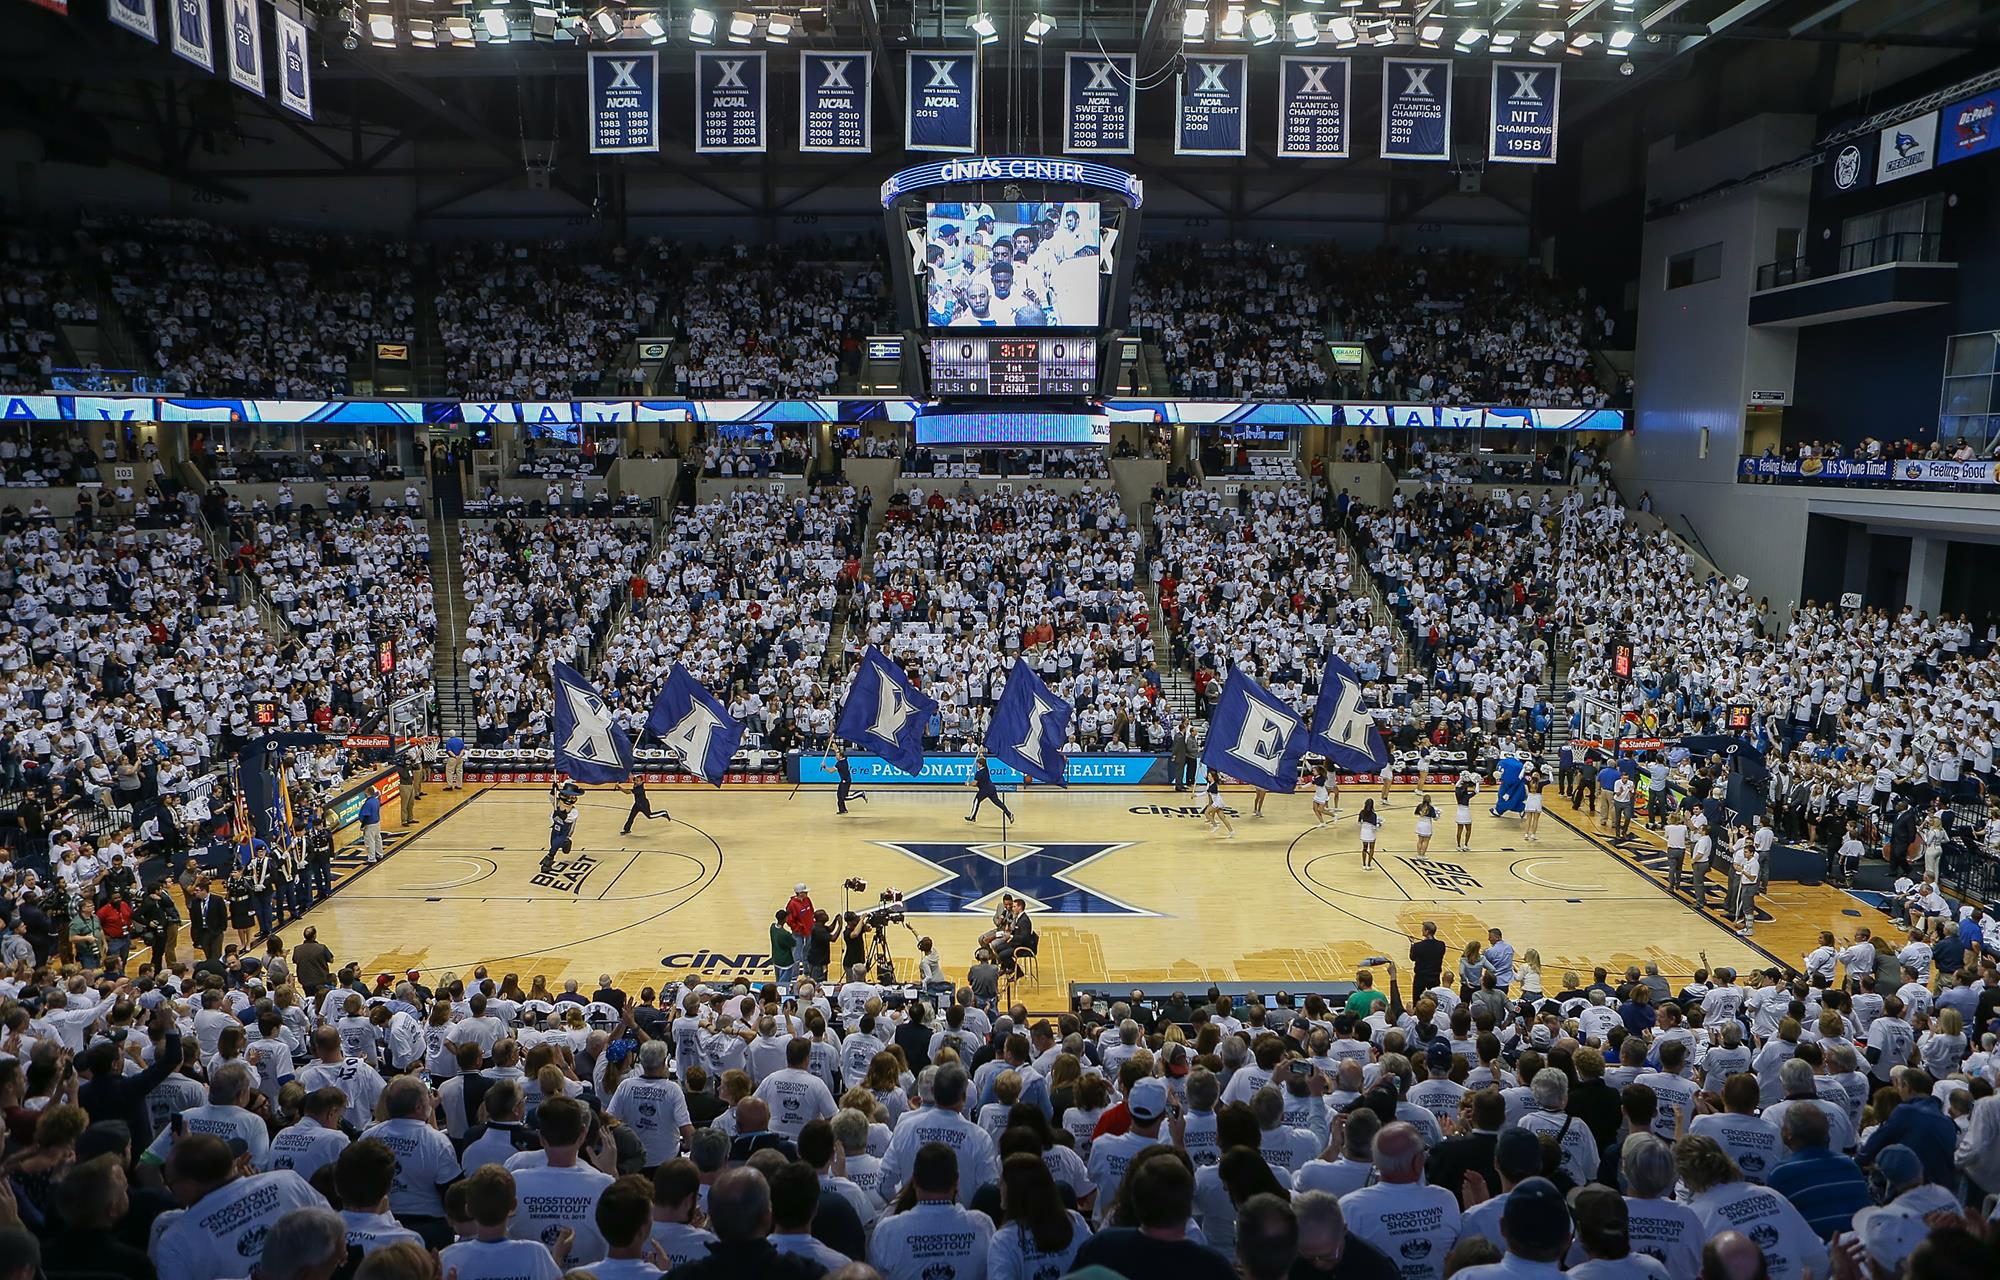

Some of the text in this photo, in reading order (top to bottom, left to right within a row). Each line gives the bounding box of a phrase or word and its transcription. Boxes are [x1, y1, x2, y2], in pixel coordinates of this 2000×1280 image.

[184, 0, 196, 15] 30
[239, 31, 249, 46] 23
[290, 57, 300, 72] 33
[608, 60, 641, 89] X
[715, 60, 747, 88] X
[819, 60, 853, 88] X
[925, 60, 958, 88] X
[1084, 61, 1118, 91] X
[1196, 63, 1229, 91] X
[1298, 65, 1331, 94] X
[1401, 67, 1433, 95] X
[1510, 71, 1541, 99] X
[916, 110, 938, 118] 2015
[1075, 105, 1110, 113] SWEET
[1184, 106, 1239, 114] ELITE EIGHT
[1392, 110, 1442, 119] CHAMPIONS
[1393, 103, 1431, 111] ATLANTIC
[839, 112, 860, 120] 2010
[1102, 114, 1125, 122] 2010
[1511, 110, 1538, 123] NIT
[706, 128, 726, 136] 1997
[1316, 126, 1340, 134] 2006
[1391, 127, 1412, 135] 2010
[1496, 124, 1552, 134] CHAMPIONS
[1287, 143, 1310, 151] 2003
[1508, 139, 1541, 151] 1958
[941, 155, 1085, 181] CINTAS CENTER
[961, 344, 973, 359] 0
[1000, 343, 1036, 358] 3:17
[1054, 344, 1065, 359] 0
[1006, 363, 1022, 372] 1st
[970, 383, 977, 392] 0
[1082, 383, 1090, 392] 0
[116, 469, 131, 477] 103
[1759, 459, 1887, 477] Feeling Good It's Skyline Time!
[1929, 462, 1987, 481] Feeling Good
[1227, 486, 1239, 494] 111
[561, 679, 625, 769] X
[1317, 671, 1376, 763] R
[661, 692, 728, 780] A
[1225, 690, 1300, 777] E
[872, 764, 974, 777] PASONATE
[661, 949, 775, 969] CINT
[916, 1127, 967, 1139] CROSSTOWN
[919, 1134, 962, 1144] SHOOTOUT
[1721, 1128, 1775, 1140] CROSSTOWN
[1727, 1134, 1773, 1145] SHOOTOUT
[199, 1183, 279, 1228] CROSSTOWN
[523, 1196, 592, 1206] CROSSTOWN
[1718, 1194, 1777, 1215] CROSSTOWN
[210, 1191, 279, 1232] SHOOTOUT
[528, 1205, 588, 1214] SHOOTOUT
[1380, 1206, 1443, 1223] CROSSTOWN
[1727, 1200, 1777, 1220] SHOOTOUT
[1386, 1214, 1441, 1230] SHOOTOUT
[906, 1232, 976, 1244] CROSSTOWN
[912, 1241, 971, 1252] SHOOTOUT
